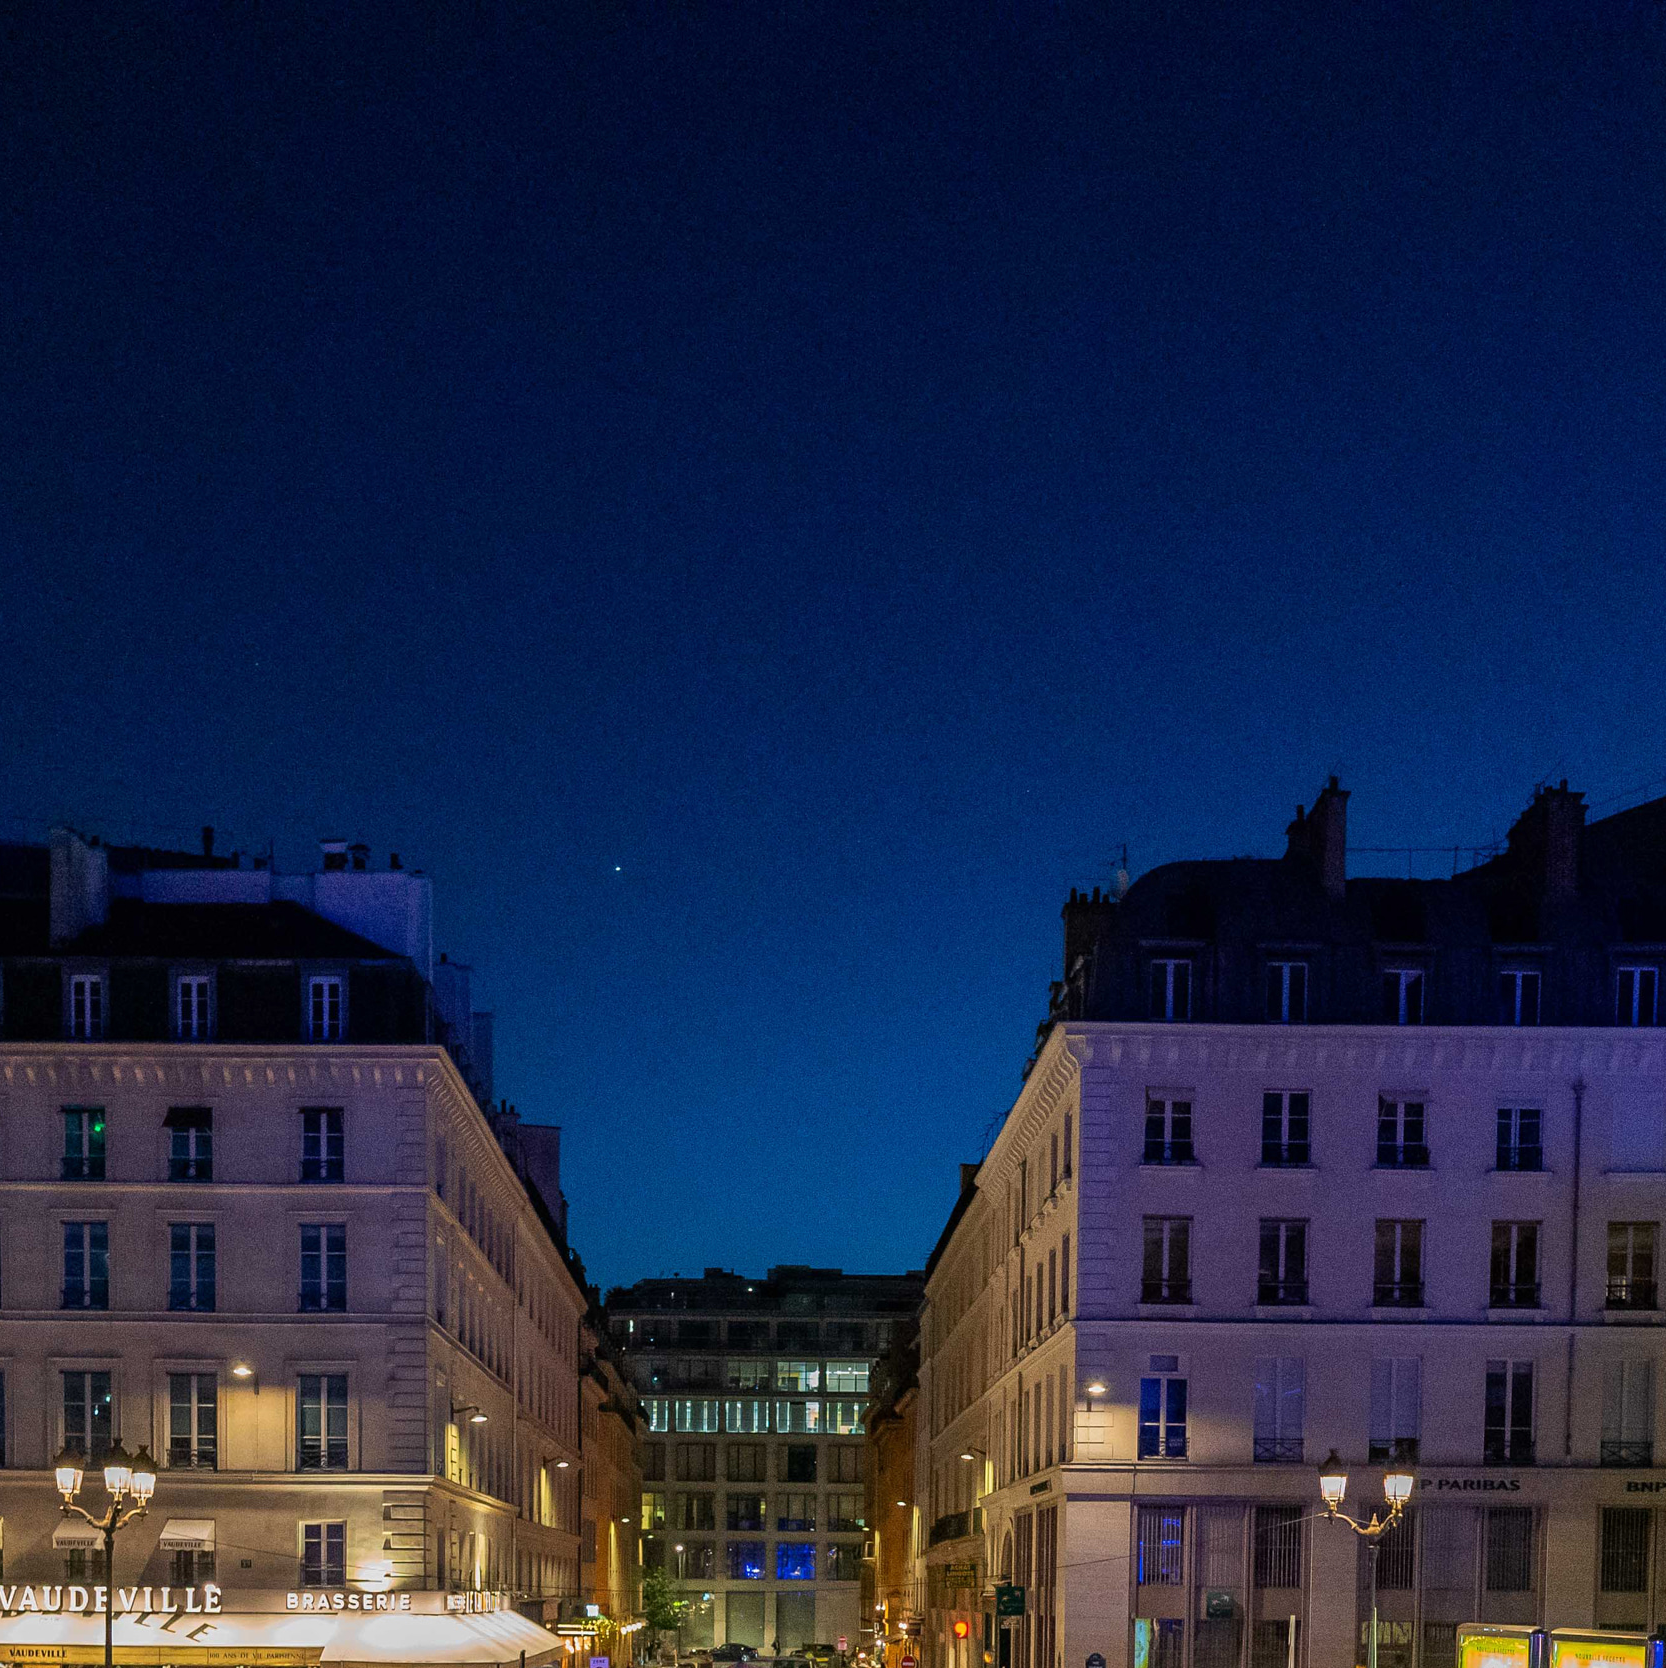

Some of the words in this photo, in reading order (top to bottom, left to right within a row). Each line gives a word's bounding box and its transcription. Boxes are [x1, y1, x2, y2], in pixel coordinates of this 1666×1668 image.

[1438, 1479, 1521, 1492] PARIBAS
[56, 1539, 95, 1547] VAUDEVILLE
[163, 1541, 202, 1549] VAUDEVILLE
[286, 1592, 412, 1611] BRASSERIE
[9, 1648, 68, 1659] VAUDEVILLE
